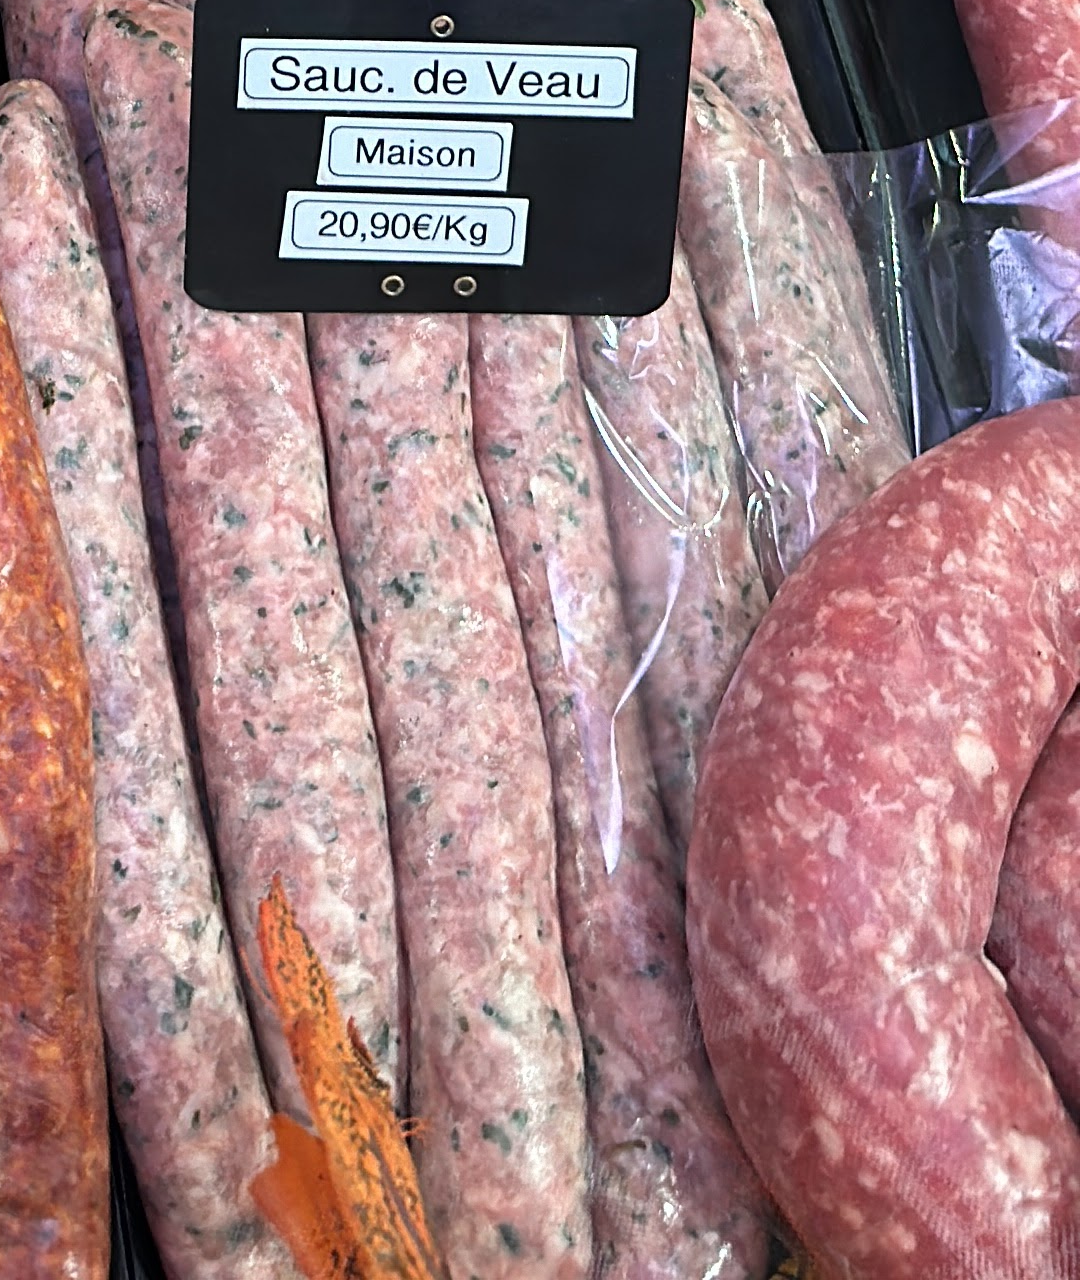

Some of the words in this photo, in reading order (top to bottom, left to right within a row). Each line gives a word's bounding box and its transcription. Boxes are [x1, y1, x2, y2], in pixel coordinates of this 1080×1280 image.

[270, 55, 396, 95] Sauc.
[413, 59, 468, 95] de
[485, 60, 601, 99] Veau
[355, 137, 477, 168] Maison
[318, 210, 489, 247] 20,90€/Kg
